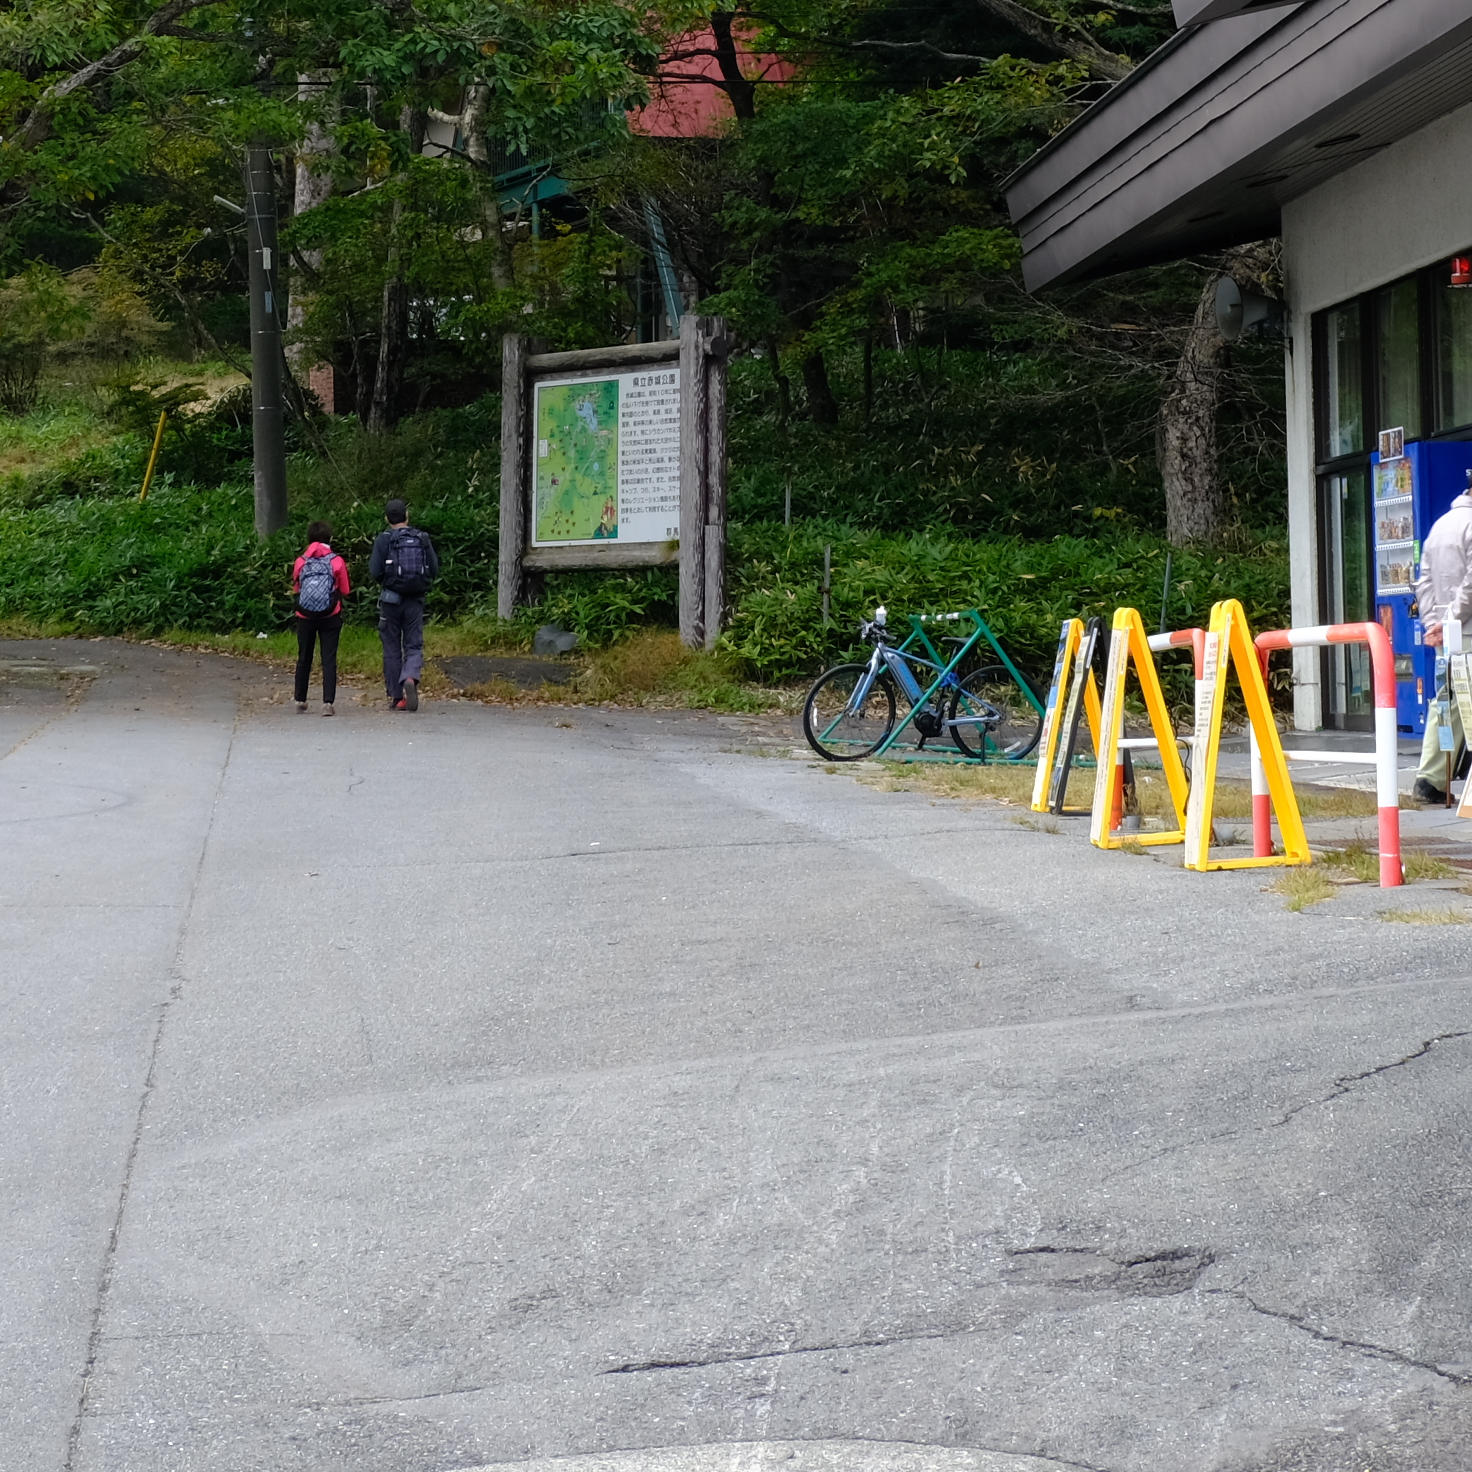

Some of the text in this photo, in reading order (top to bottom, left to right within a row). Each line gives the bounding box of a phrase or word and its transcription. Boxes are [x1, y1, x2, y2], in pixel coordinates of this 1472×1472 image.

[633, 373, 676, 388] 県立赤城公園
